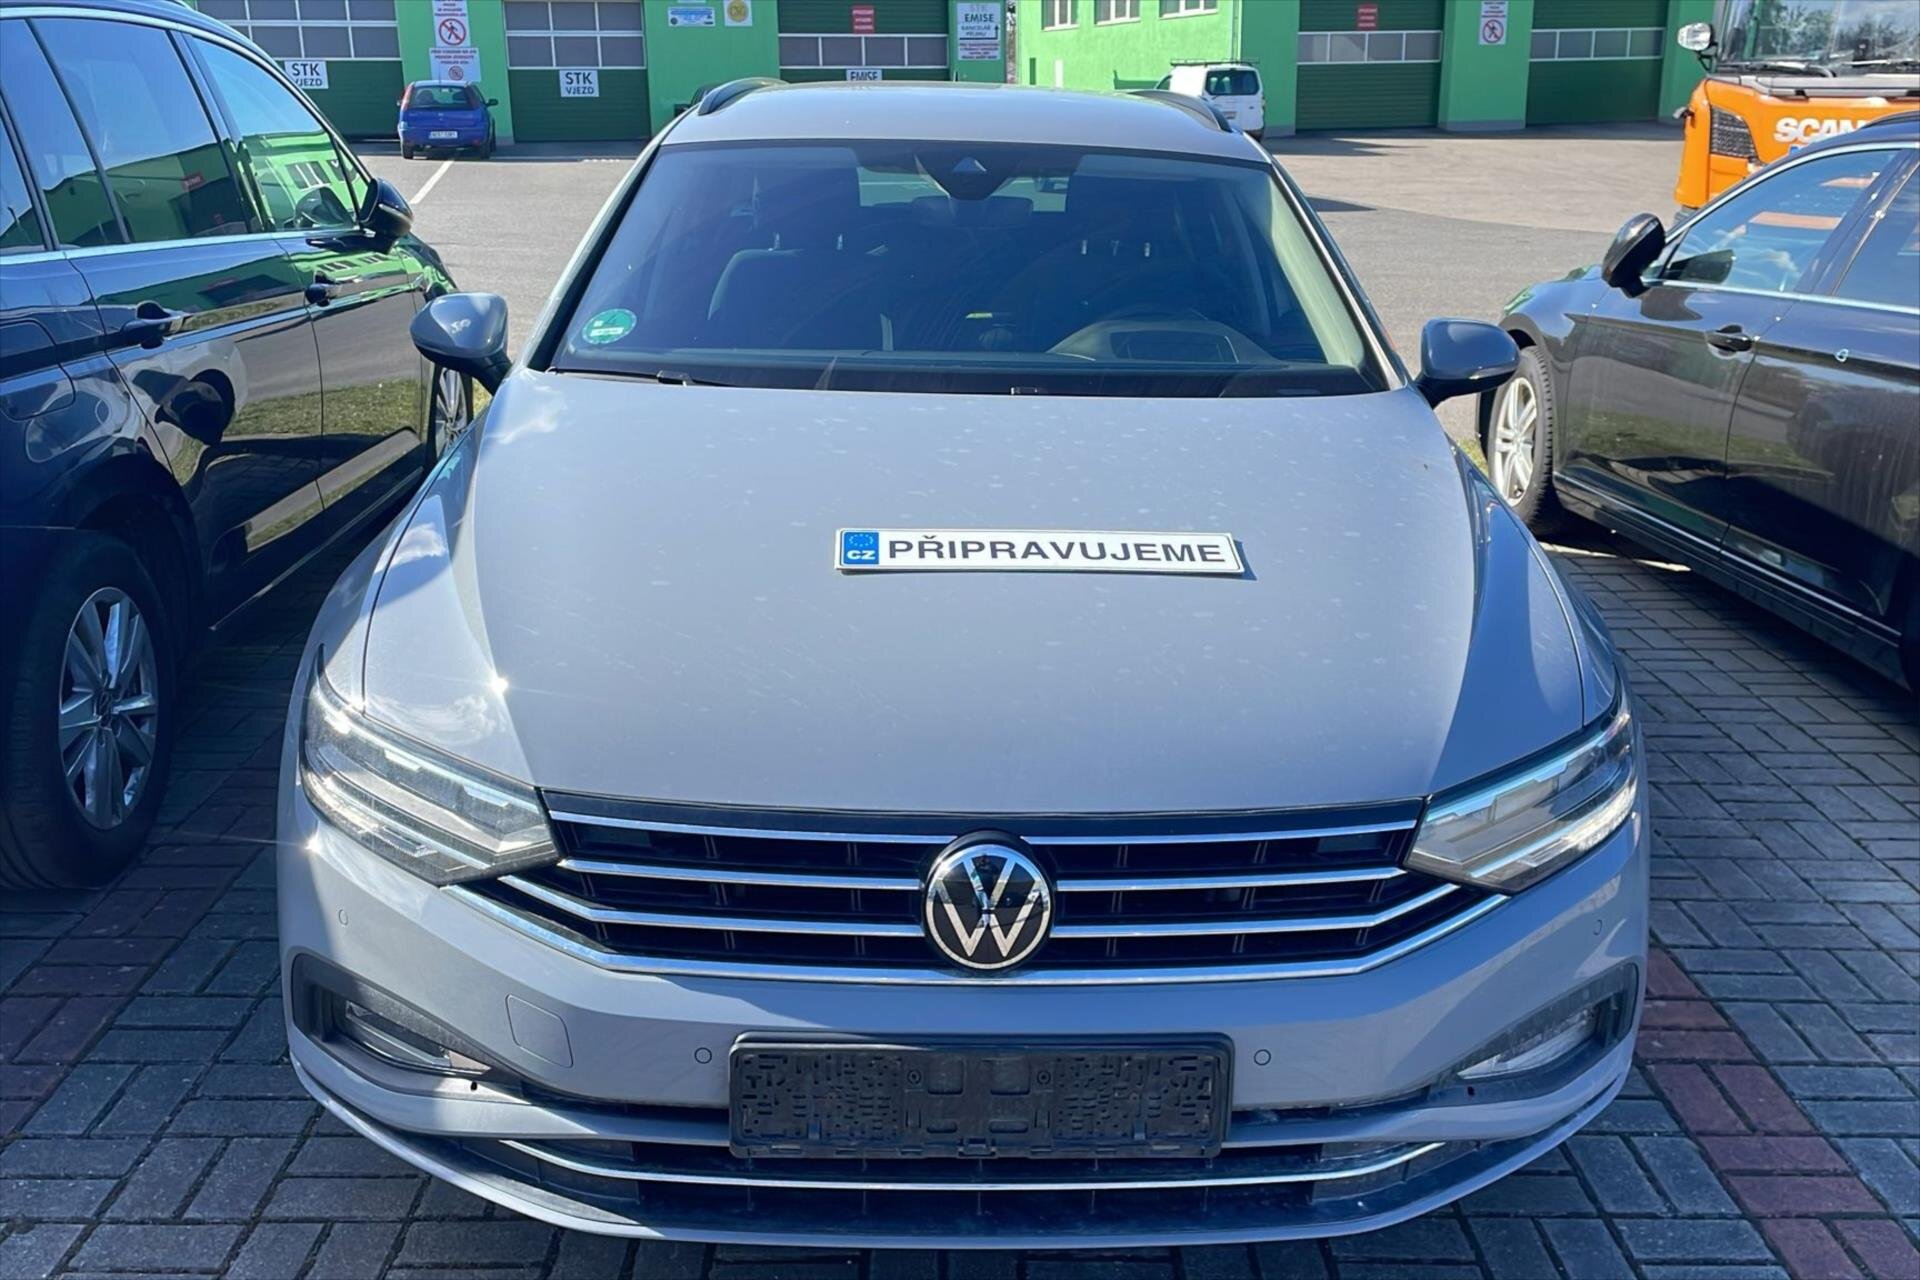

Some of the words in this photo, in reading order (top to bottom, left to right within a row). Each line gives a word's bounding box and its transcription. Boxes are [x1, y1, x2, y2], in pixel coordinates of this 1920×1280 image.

[964, 13, 994, 22] EMISE
[291, 63, 320, 76] STK
[565, 72, 592, 85] STK
[565, 86, 595, 95] VJEZD
[1773, 117, 1870, 144] SCAN
[847, 550, 876, 560] CZ
[889, 535, 1226, 562] PŘIPRAVUJEME
